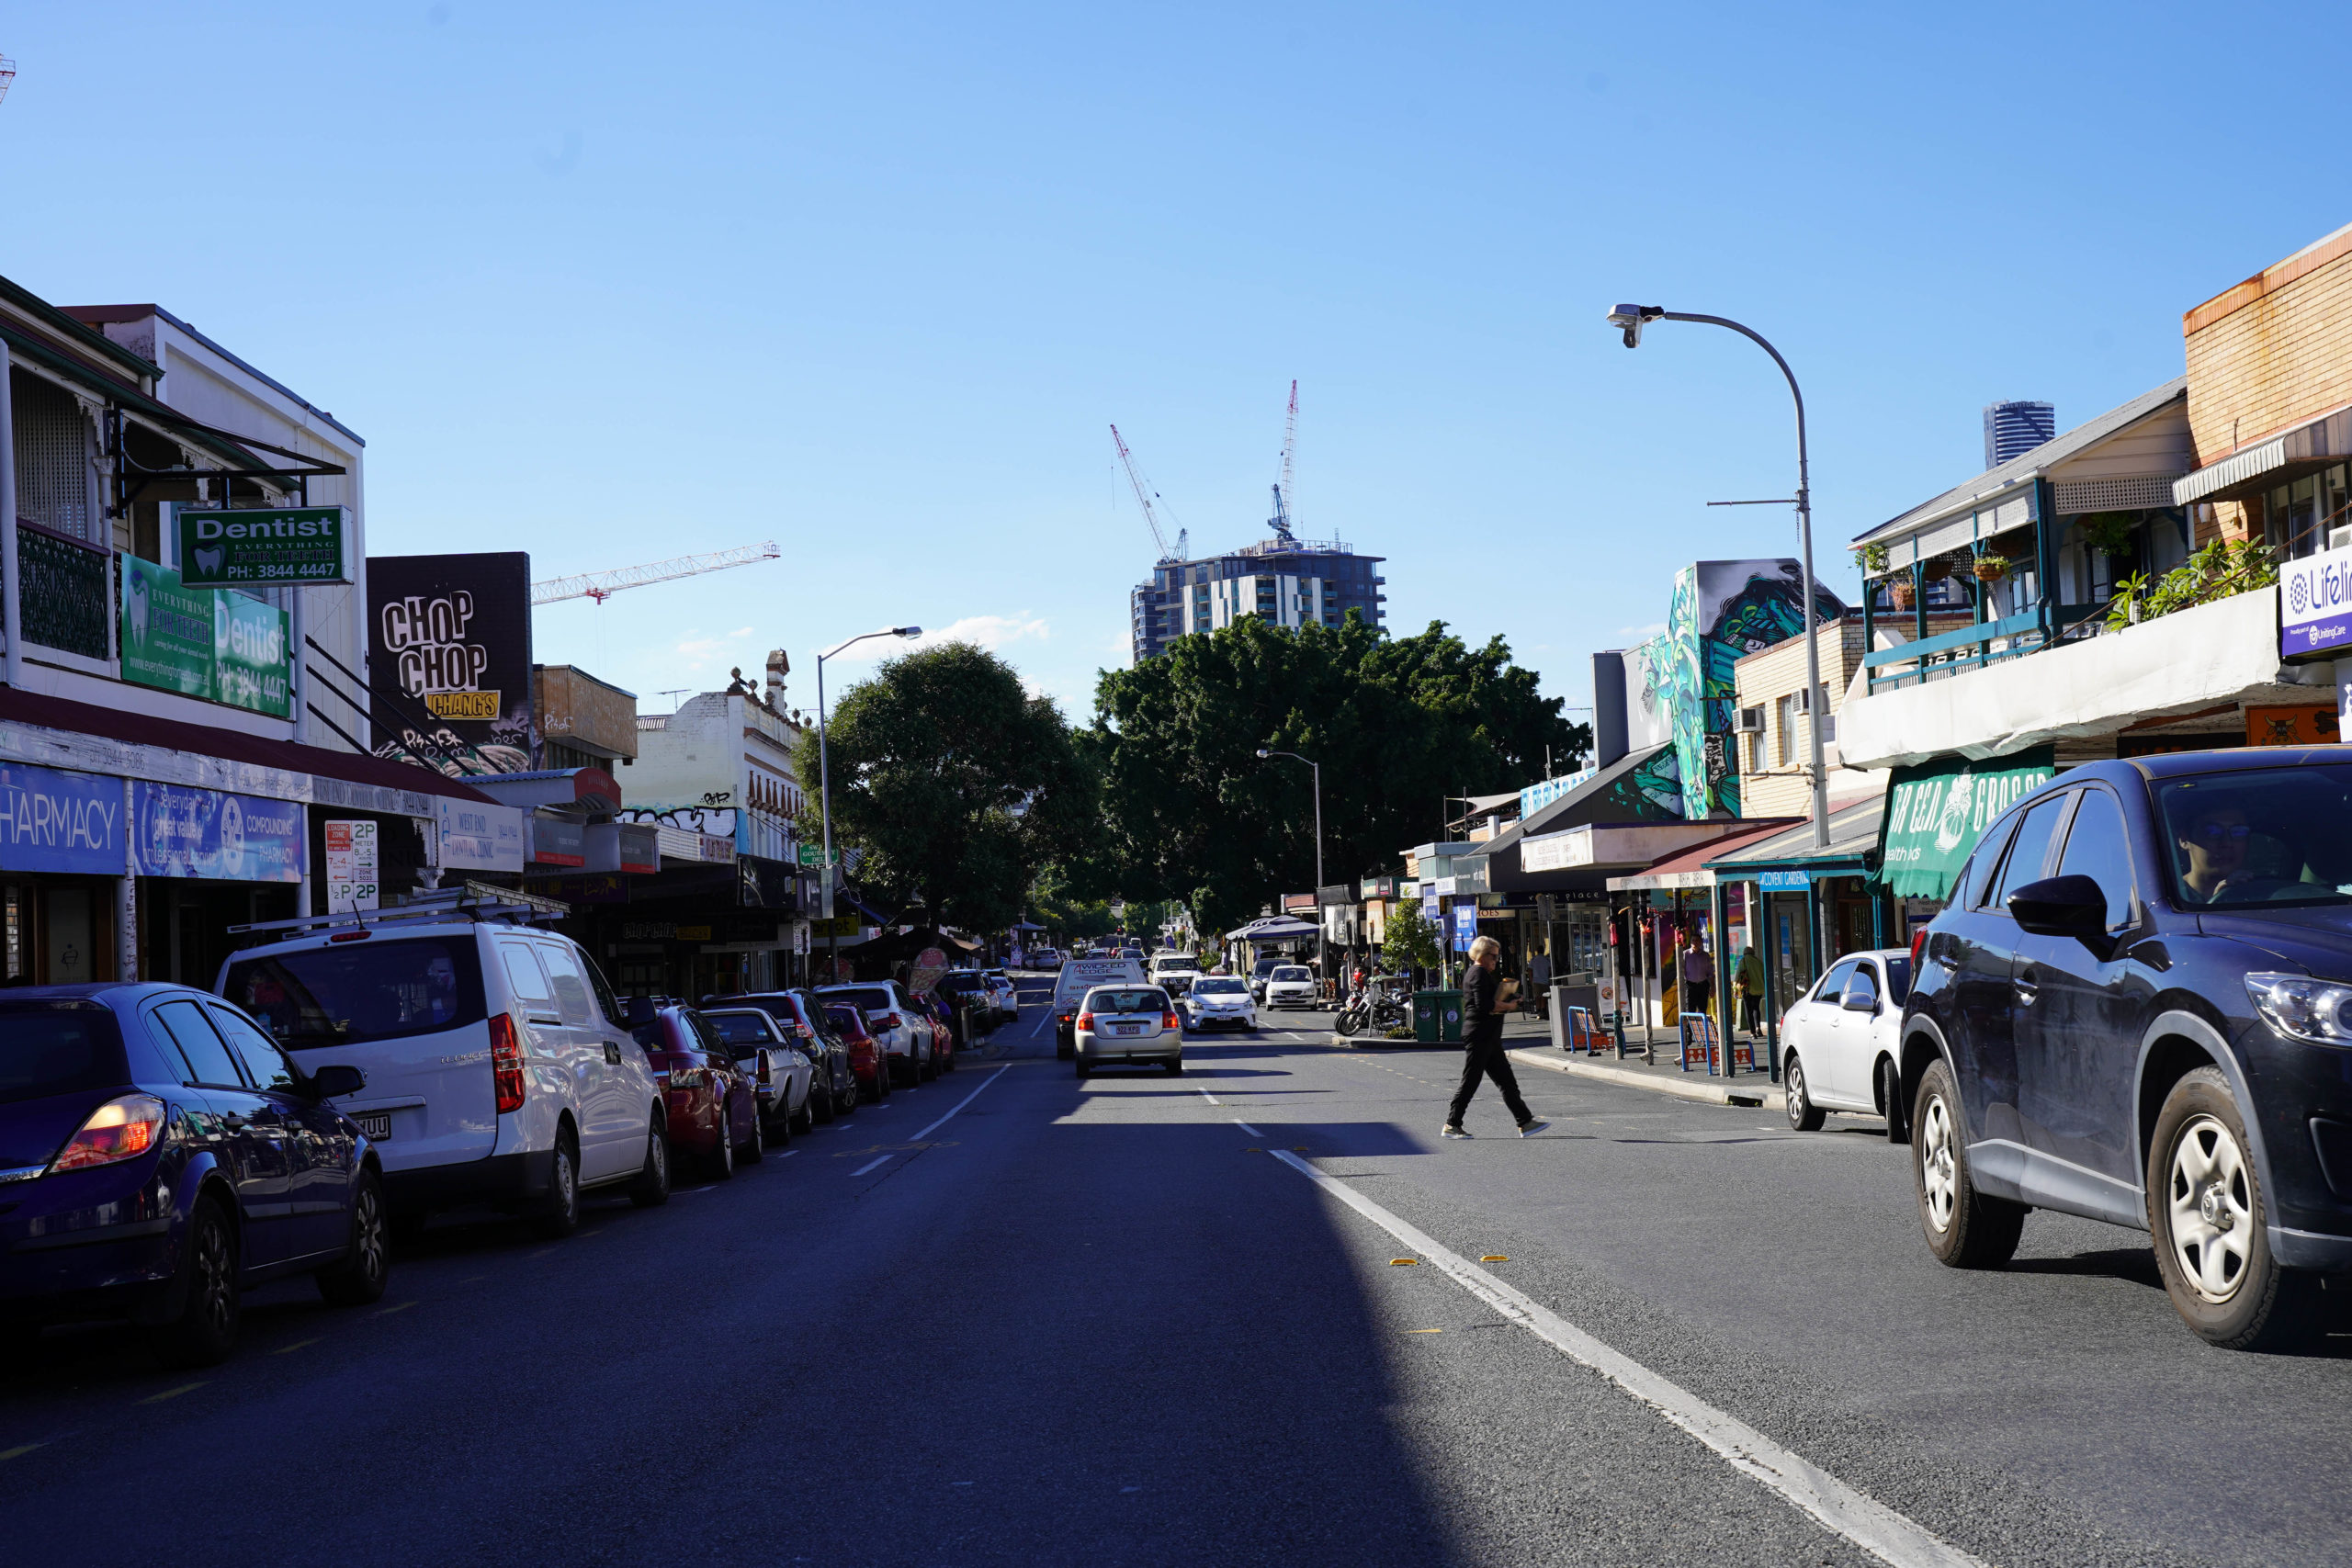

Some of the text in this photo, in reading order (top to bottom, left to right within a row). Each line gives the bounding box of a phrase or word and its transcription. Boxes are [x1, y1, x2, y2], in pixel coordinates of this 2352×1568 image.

[196, 517, 333, 539] Dentist
[234, 549, 334, 562] FOR TEETH
[235, 541, 334, 550] EVERYTHING
[228, 563, 335, 579] PH: 3844 4447
[153, 589, 209, 617] EVERYTHING
[153, 608, 210, 645] FOR TEETH
[382, 590, 473, 652] CHOP
[216, 599, 287, 667] Dentist
[2318, 626, 2346, 639] UnitingCare
[399, 643, 487, 698] CHOP
[216, 660, 287, 705] PH: 3844 4447
[432, 694, 496, 716] CHANG'S
[162, 791, 196, 816] everyday
[154, 817, 176, 840] great
[176, 816, 198, 838] value
[246, 815, 293, 836] COMPOUNDING
[355, 824, 375, 838] 2P
[259, 845, 293, 863] PHARMACY
[1764, 871, 1804, 886] COVENT GARDEN
[356, 885, 376, 898] 2P
[1566, 891, 1600, 901] place
